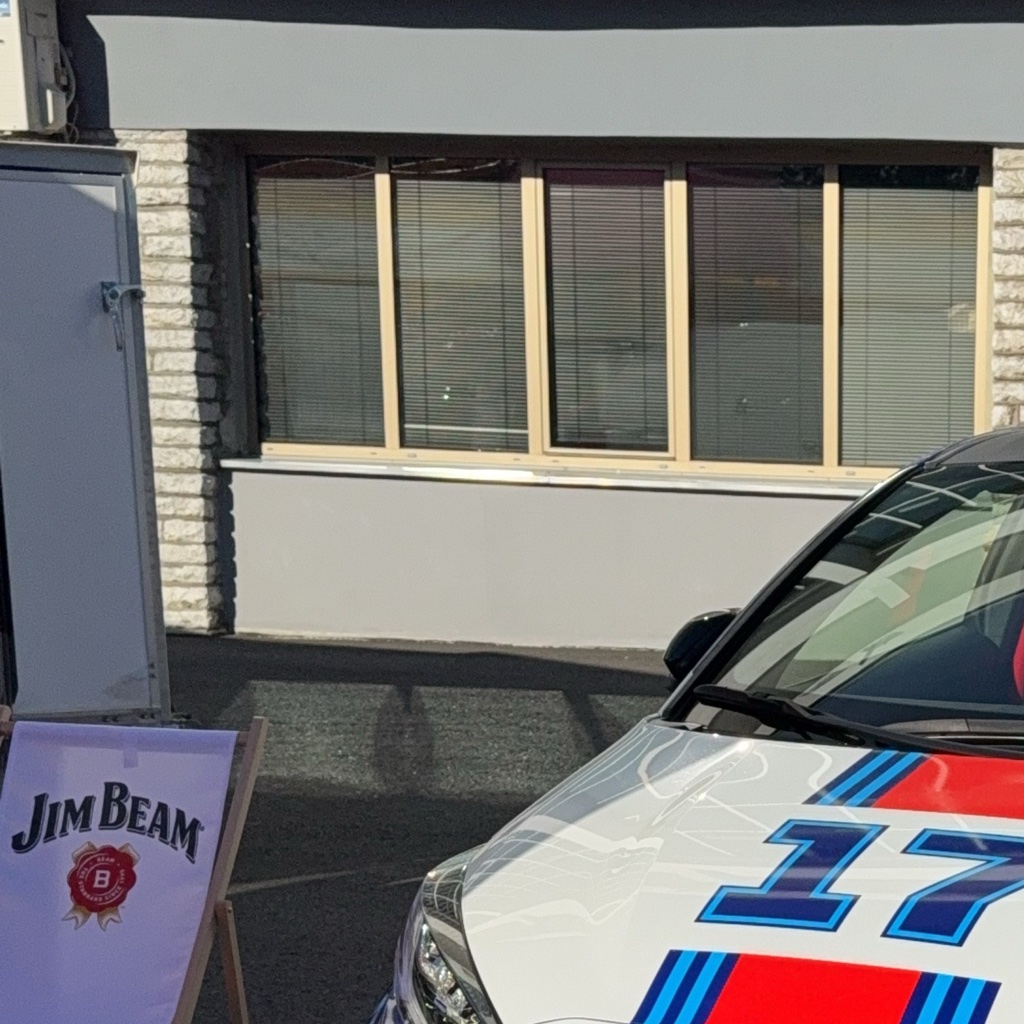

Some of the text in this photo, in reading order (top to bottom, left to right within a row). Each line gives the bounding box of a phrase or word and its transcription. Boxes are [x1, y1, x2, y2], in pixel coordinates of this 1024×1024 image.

[11, 781, 203, 864] JIM BEAM
[93, 869, 111, 889] B
